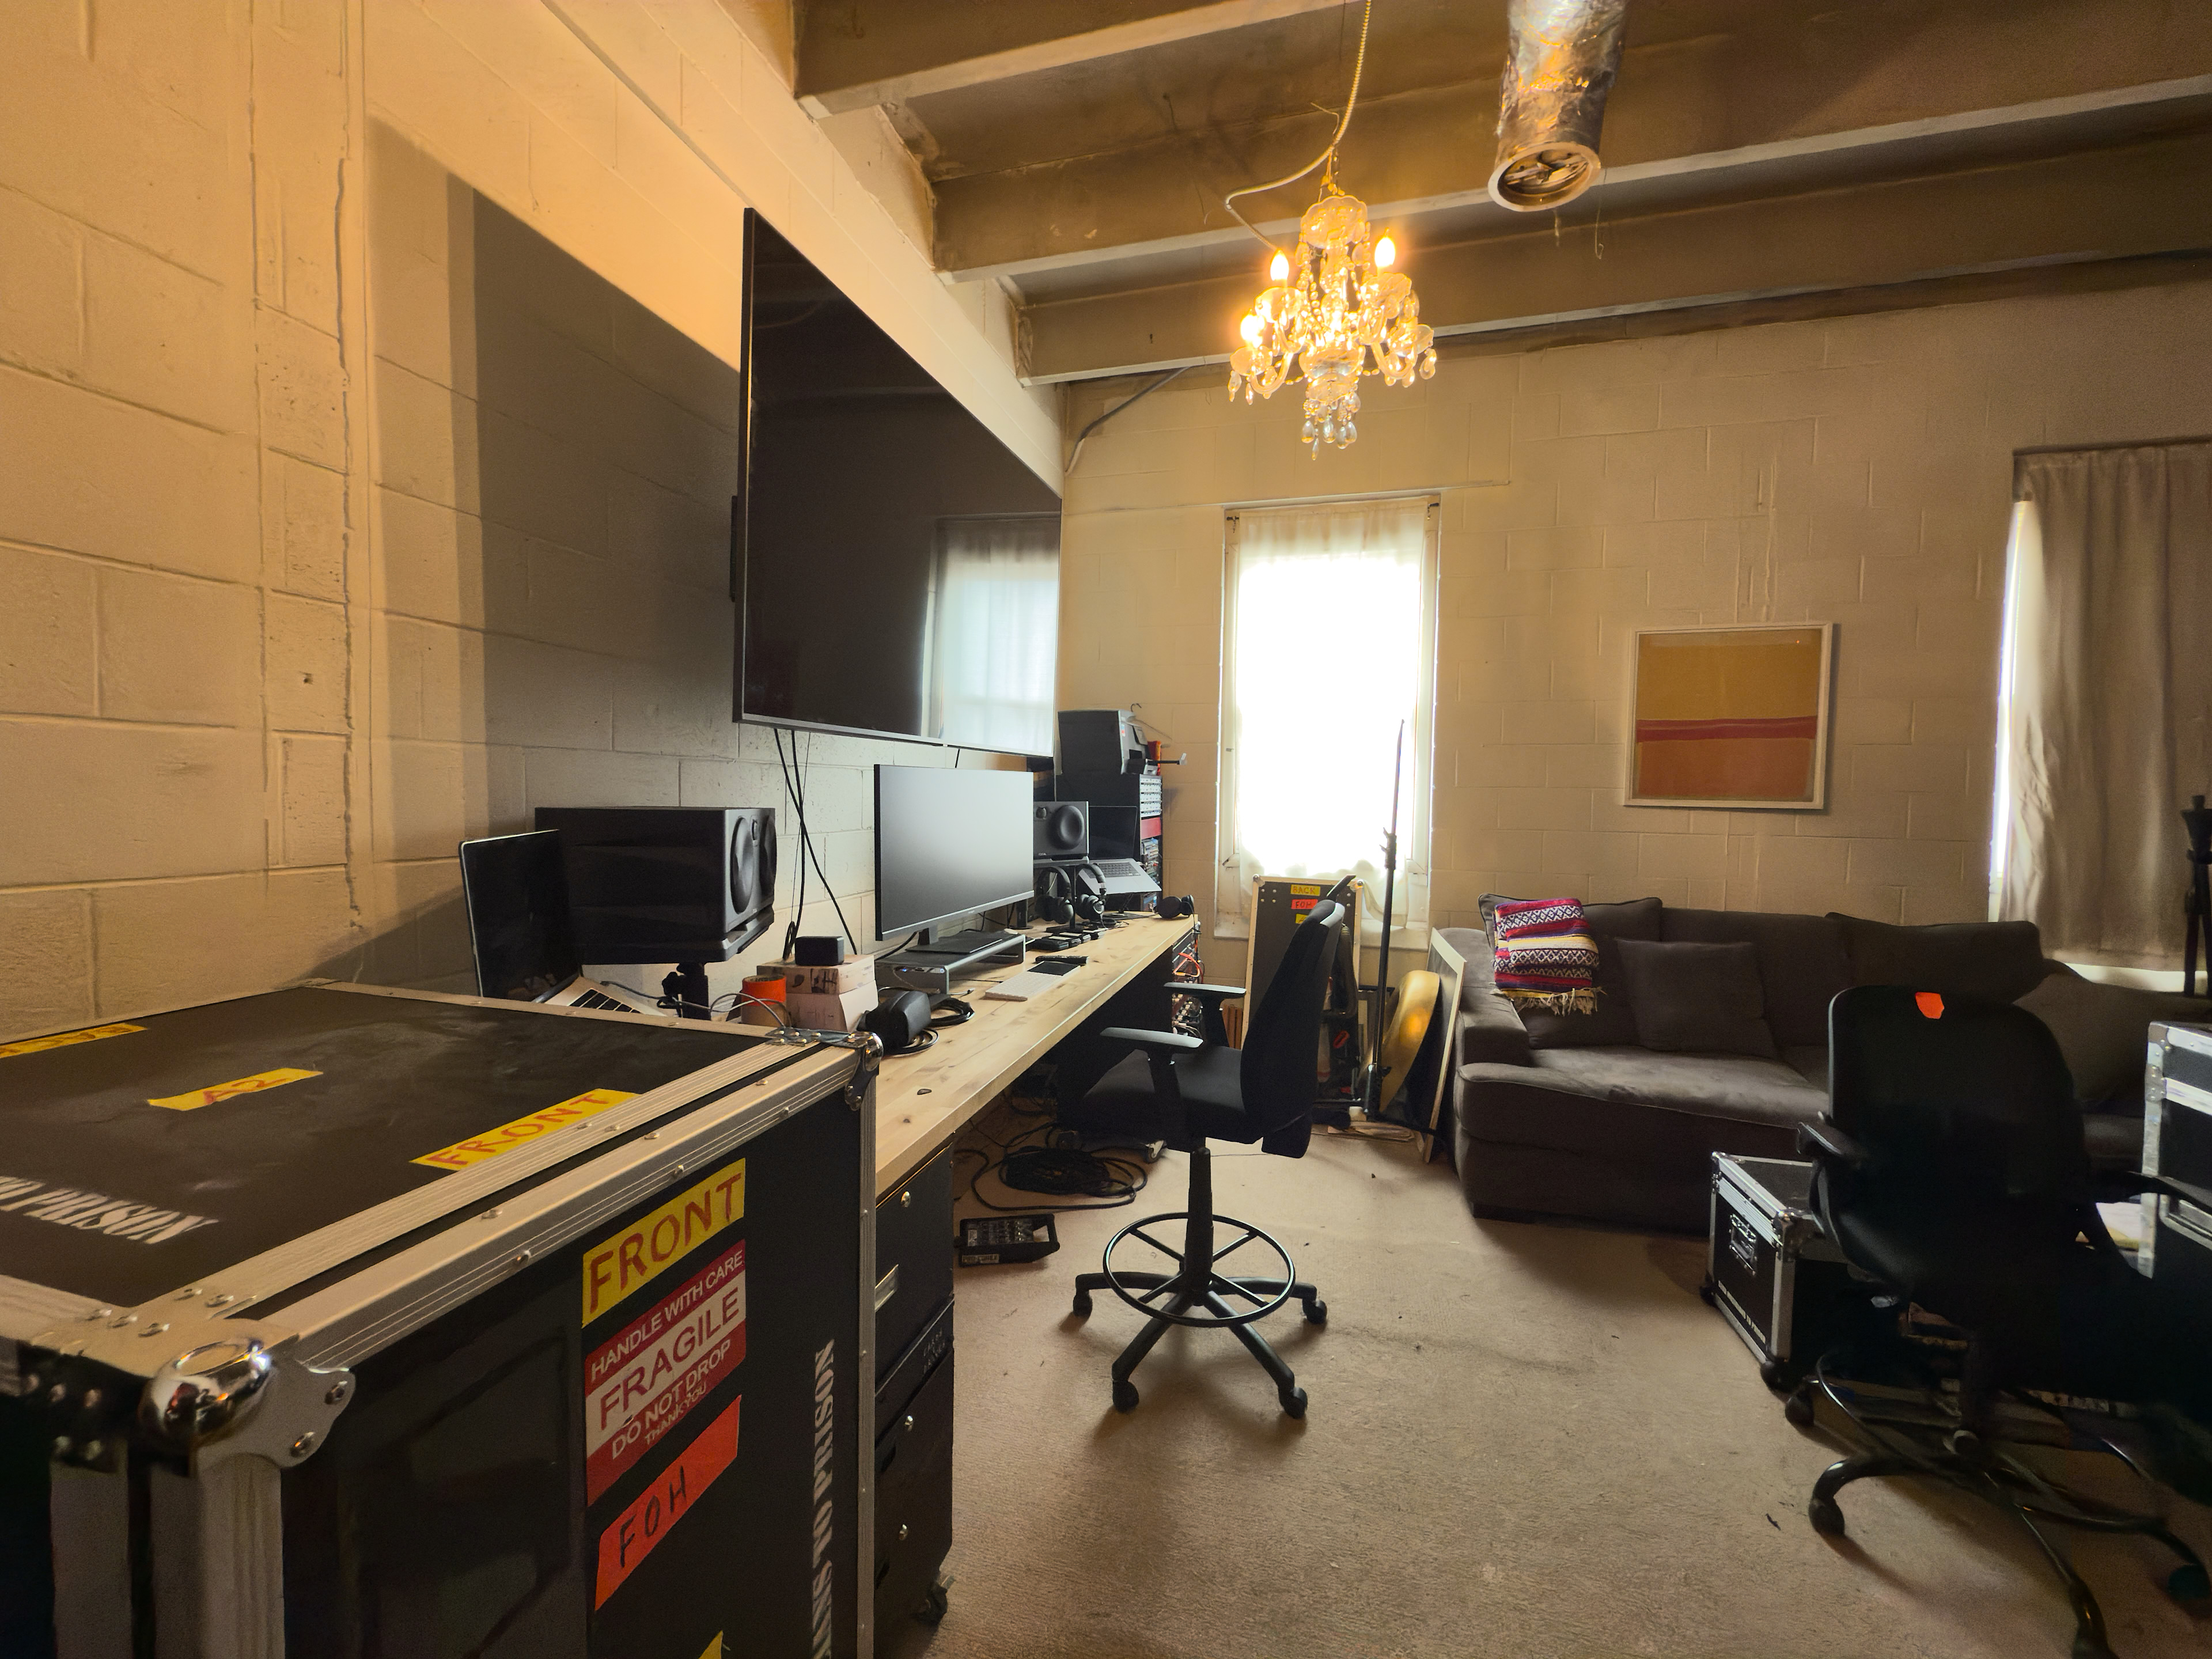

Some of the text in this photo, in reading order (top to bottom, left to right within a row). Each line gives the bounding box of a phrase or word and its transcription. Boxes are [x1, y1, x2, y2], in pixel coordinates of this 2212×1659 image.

[1293, 885, 1316, 894] BACK
[426, 1093, 609, 1166] FRONT
[589, 1172, 742, 1315] FRONT
[591, 1249, 744, 1382] HANDLE WITH CARE
[600, 1286, 740, 1431] FRAGILE
[612, 1338, 731, 1460] DO NOT DROP
[645, 1402, 684, 1445] THANK
[813, 1339, 835, 1506] PRISON
[619, 1465, 688, 1568] FOH
[812, 1499, 833, 1569] TO
